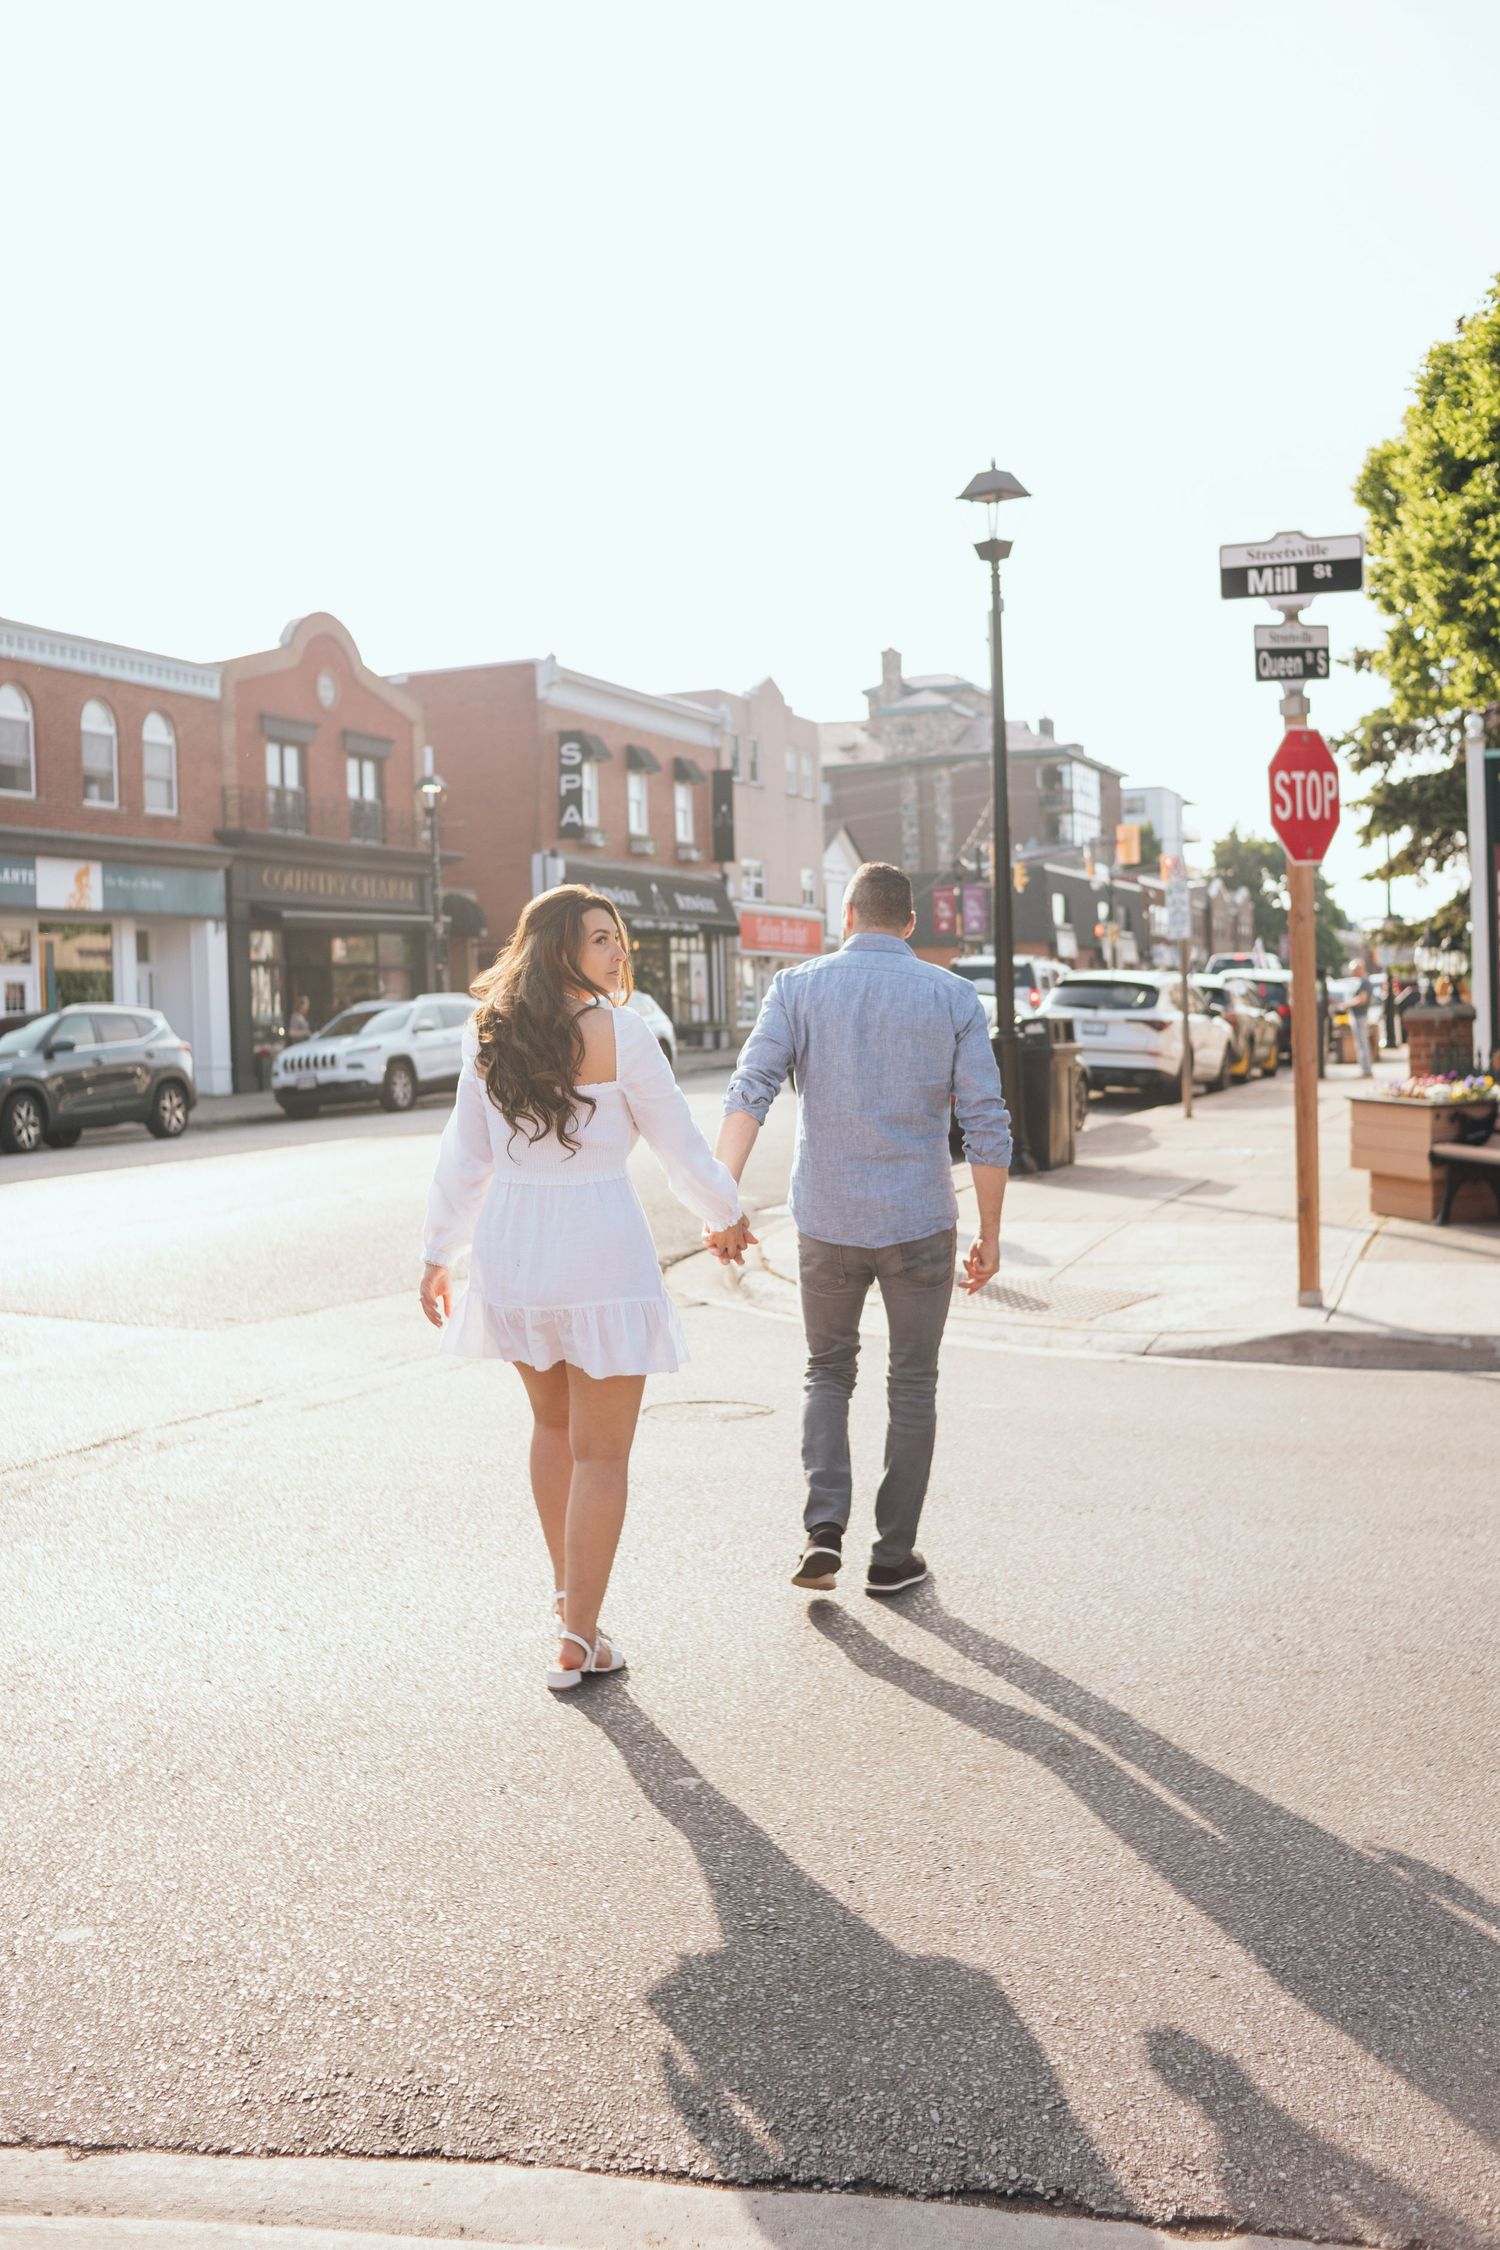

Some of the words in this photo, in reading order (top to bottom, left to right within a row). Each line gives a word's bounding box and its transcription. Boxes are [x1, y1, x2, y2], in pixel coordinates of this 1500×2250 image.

[1246, 543, 1329, 561] Streetsville
[1247, 565, 1298, 595] Mill
[1312, 562, 1333, 579] St
[1258, 650, 1304, 677] Queen
[1316, 649, 1328, 676] S
[560, 742, 582, 827] SPA
[1274, 769, 1338, 821] STOP
